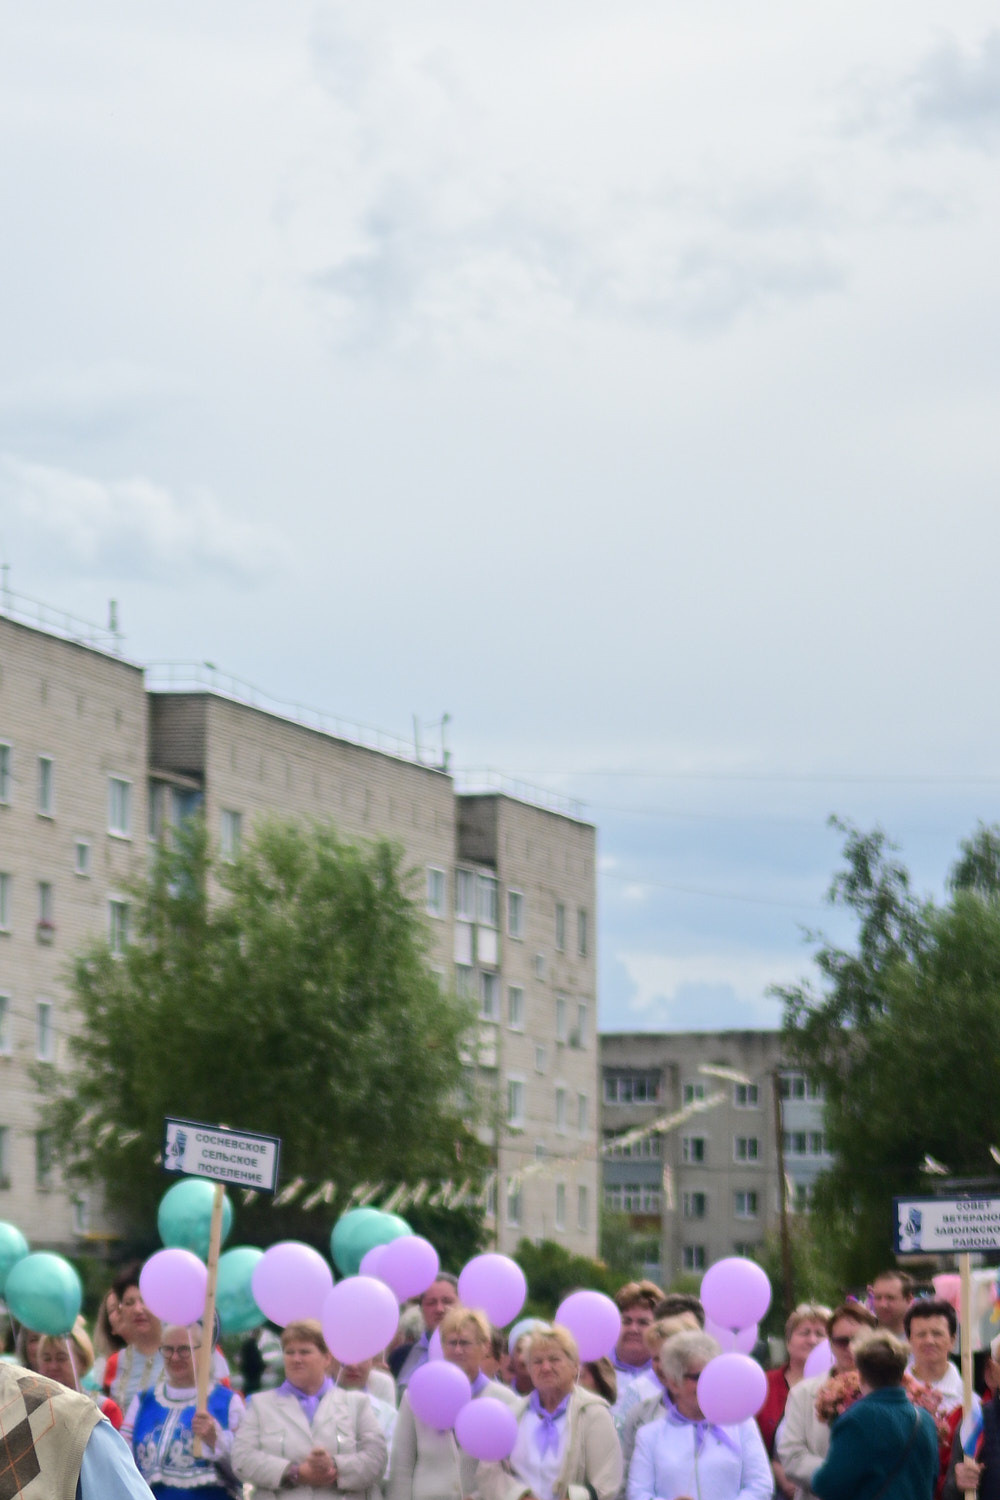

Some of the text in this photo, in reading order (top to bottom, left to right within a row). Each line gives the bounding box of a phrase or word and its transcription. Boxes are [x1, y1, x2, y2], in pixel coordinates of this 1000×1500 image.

[195, 1133, 267, 1155] СОСНЕВСКОЕ
[201, 1148, 258, 1168] СЕЛЬСКОЕ
[198, 1162, 263, 1184] ПОСЕЛЕНИЕ
[956, 1201, 992, 1211] СОВЕТ
[942, 1213, 1000, 1223] ВЕТЕРАНО
